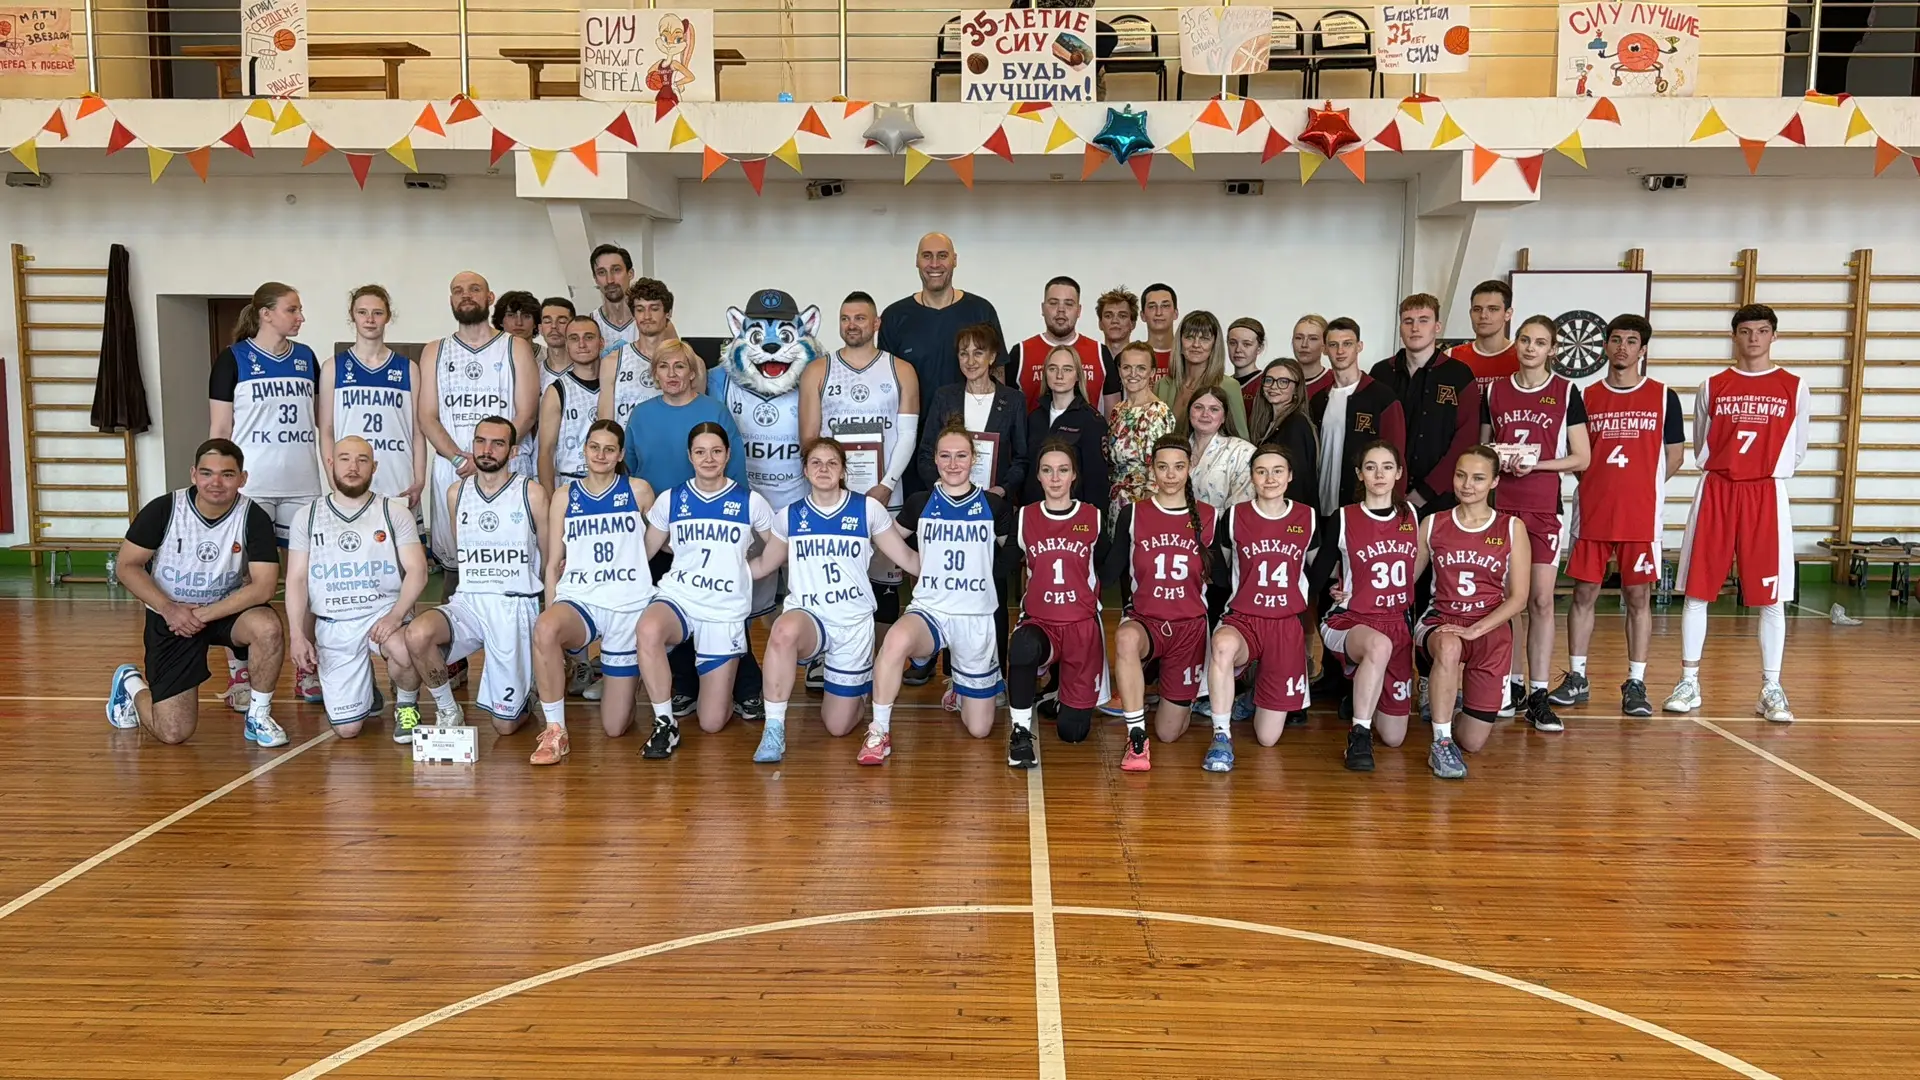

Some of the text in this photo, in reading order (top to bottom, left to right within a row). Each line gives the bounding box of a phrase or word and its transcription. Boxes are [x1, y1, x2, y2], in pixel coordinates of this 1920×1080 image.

[19, 10, 57, 24] МАТЧ
[251, 7, 293, 32] СЕРДЦЕМ
[1181, 7, 1195, 35] 35
[1383, 6, 1449, 22] БАСКЕТБОЛ
[1569, 3, 1699, 38] СИУ ЛУЧШИЕ
[33, 22, 45, 31] СО
[586, 15, 635, 46] СИУ
[962, 9, 1089, 47] 35-ЛЕТИЕ
[1387, 22, 1413, 45] 35
[25, 30, 69, 45] ЗВЕЗДОЙ
[996, 33, 1049, 54] СИУ
[585, 46, 644, 67] РАНХиГС
[1407, 43, 1439, 63] СИУ
[0, 59, 26, 69] ПЕРЕД
[31, 60, 37, 70] К
[1003, 62, 1066, 81] БУДЬ
[584, 67, 643, 92] ВПЕРЁД
[966, 76, 1092, 101] ЛУЧШИМ!
[619, 371, 633, 382] 28
[252, 381, 312, 402] ДИНАМО
[342, 389, 404, 410] ДИНАМО
[828, 385, 842, 396] 23
[1715, 394, 1788, 405] ПРЕЗИДЕНТСКАЯ
[445, 394, 507, 409] СИБИРЬ
[733, 401, 742, 415] 23
[1539, 396, 1556, 405] АСБ
[279, 404, 298, 424] 33
[566, 408, 578, 420] 10
[1497, 409, 1553, 429] РАНХиГС
[1588, 411, 1658, 421] ПРЕЗИДЕНТСКАЯ
[1715, 402, 1786, 418] АКАДЕМИЯ
[363, 413, 382, 432] 28
[1590, 418, 1657, 433] АКАДЕМИЯ
[252, 431, 315, 443] ГК СМСС
[1514, 429, 1530, 445] 7
[1737, 430, 1758, 454] 7
[1606, 445, 1629, 468] 4
[747, 471, 794, 480] REEDOM
[613, 492, 629, 501] FON
[613, 499, 628, 507] BET
[723, 500, 741, 509] FON
[461, 512, 468, 524] 2
[723, 508, 740, 516] BET
[841, 516, 858, 524] FON
[567, 515, 636, 542] ДИНАМО
[677, 523, 741, 546] ДИНАМО
[841, 523, 858, 531] BET
[924, 522, 988, 544] ДИНАМО
[1072, 524, 1089, 532] АСБ
[1286, 525, 1304, 534] АСБ
[176, 538, 182, 554] 1
[313, 533, 324, 546] 11
[1029, 538, 1088, 558] РАНХиГС
[1141, 533, 1199, 555] РАНХиГС
[1485, 537, 1504, 546] АСБ
[1547, 533, 1558, 551] 7
[457, 549, 529, 564] СИБИРЬ
[593, 541, 614, 564] 88
[701, 548, 711, 569] 7
[796, 539, 861, 561] ДИНАМО
[1242, 539, 1302, 561] РАНХиГС
[1356, 540, 1417, 563] РАНХиГС
[944, 549, 965, 571] 30
[1154, 553, 1189, 580] 15
[1437, 550, 1501, 572] РАНХиГС
[1633, 552, 1654, 575] 4
[311, 560, 396, 580] СИБИРЬ
[466, 568, 520, 578] FREEDOM
[570, 568, 637, 584] ГК СМСС
[822, 562, 841, 584] 15
[1052, 558, 1065, 585] 1
[1258, 560, 1288, 588] 14
[1371, 560, 1407, 589] 30
[326, 579, 381, 592] ЭКСПРЕСС
[691, 574, 735, 592] СМСС
[922, 576, 986, 592] ГК СМСС
[1457, 571, 1477, 597] 5
[1762, 575, 1779, 600] 7
[325, 593, 387, 606] FREEDOM
[802, 586, 864, 607] ГК СМСС
[1044, 590, 1077, 604] СИУ
[1153, 586, 1185, 600] СИУ
[1254, 593, 1288, 607] СИУ
[1375, 592, 1407, 607] СИУ
[1183, 664, 1203, 685] 15
[503, 687, 515, 702] 2
[1286, 674, 1306, 697] 14
